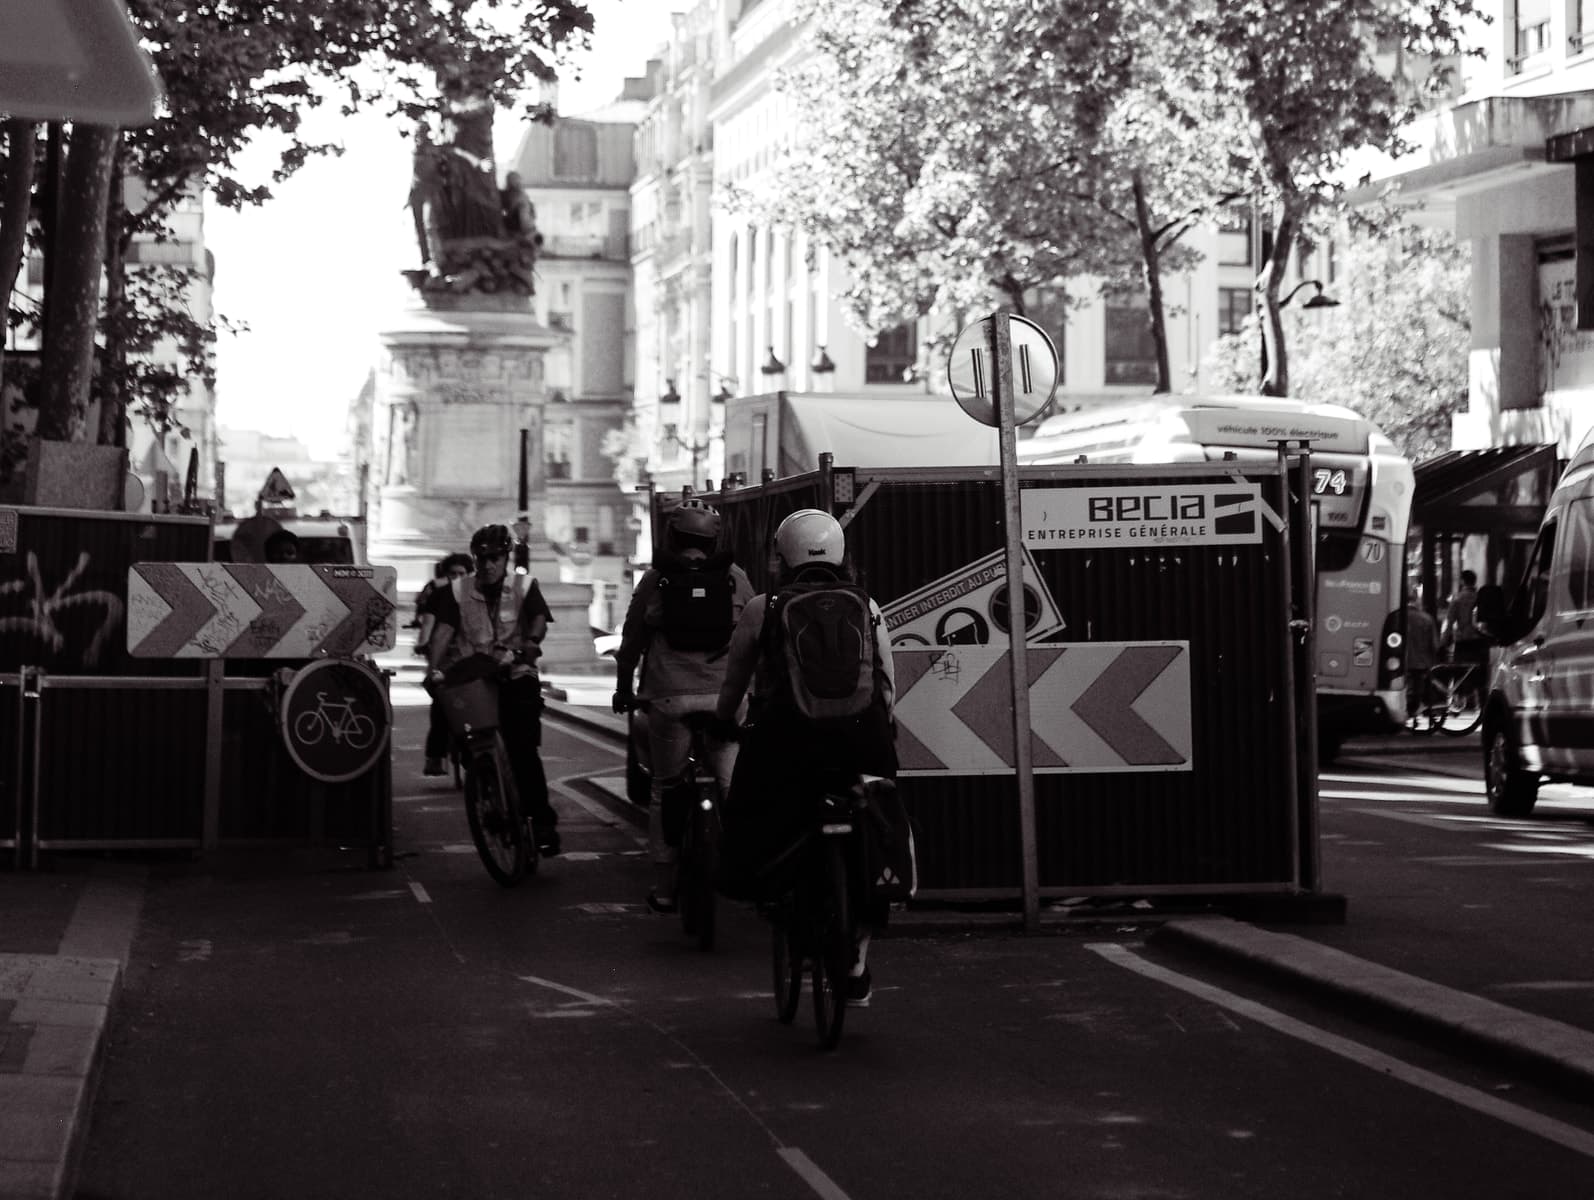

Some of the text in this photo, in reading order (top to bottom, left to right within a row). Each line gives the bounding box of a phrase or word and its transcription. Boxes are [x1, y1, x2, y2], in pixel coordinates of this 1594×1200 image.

[1217, 424, 1339, 440] véhicule 100% électrique
[1314, 468, 1347, 495] 74
[1028, 523, 1207, 540] ENTREPRISE GÉNÉRALE
[1365, 542, 1382, 562] 70
[885, 604, 921, 629] ANTIER
[920, 582, 967, 613] INTERDIT
[967, 574, 983, 590] AU
